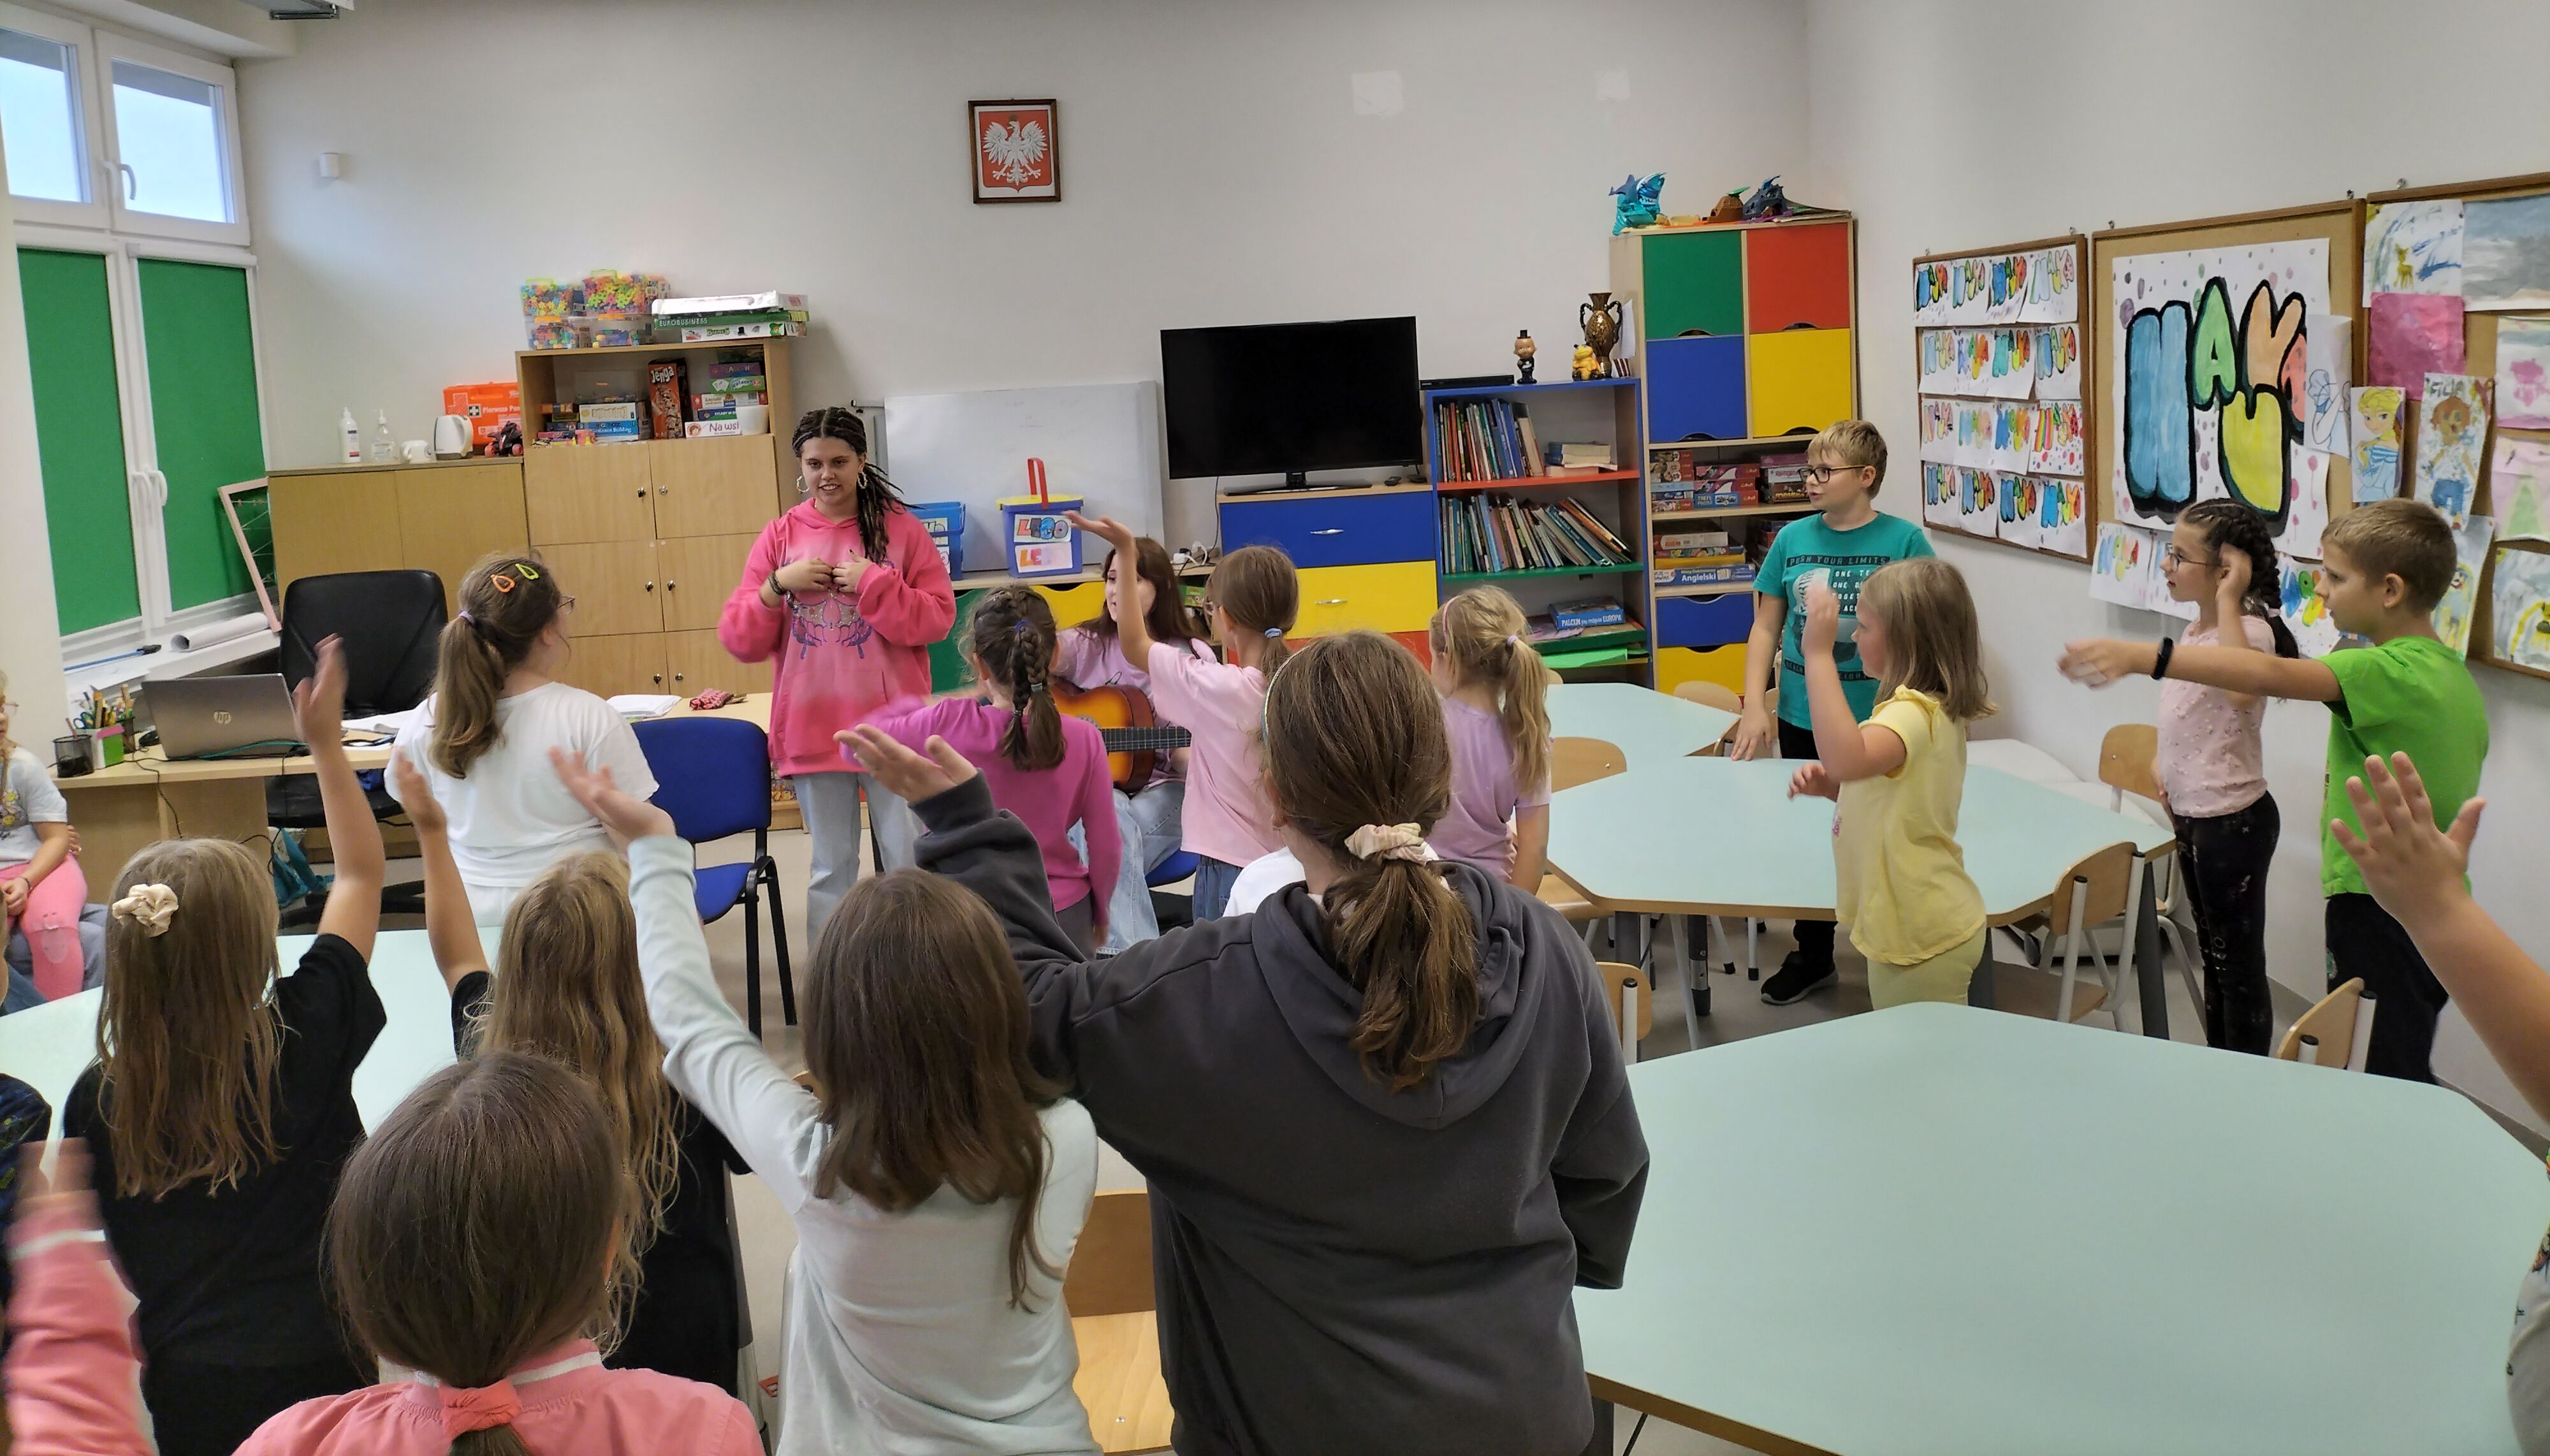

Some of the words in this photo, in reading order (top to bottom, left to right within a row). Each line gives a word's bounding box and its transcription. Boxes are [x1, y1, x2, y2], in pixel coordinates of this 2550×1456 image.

[650, 366, 674, 383] Jenga
[709, 422, 722, 432] Na
[724, 421, 740, 430] wsi
[1016, 517, 1069, 540] LEGO
[1789, 555, 1811, 566] PUSH
[1817, 555, 1843, 565] YOUR
[1848, 556, 1887, 565] LIMITS
[1681, 572, 1717, 583] Angielski
[1561, 618, 1580, 627] PALCEM
[1603, 614, 1622, 623] EUROPA
[214, 711, 231, 725] hp
